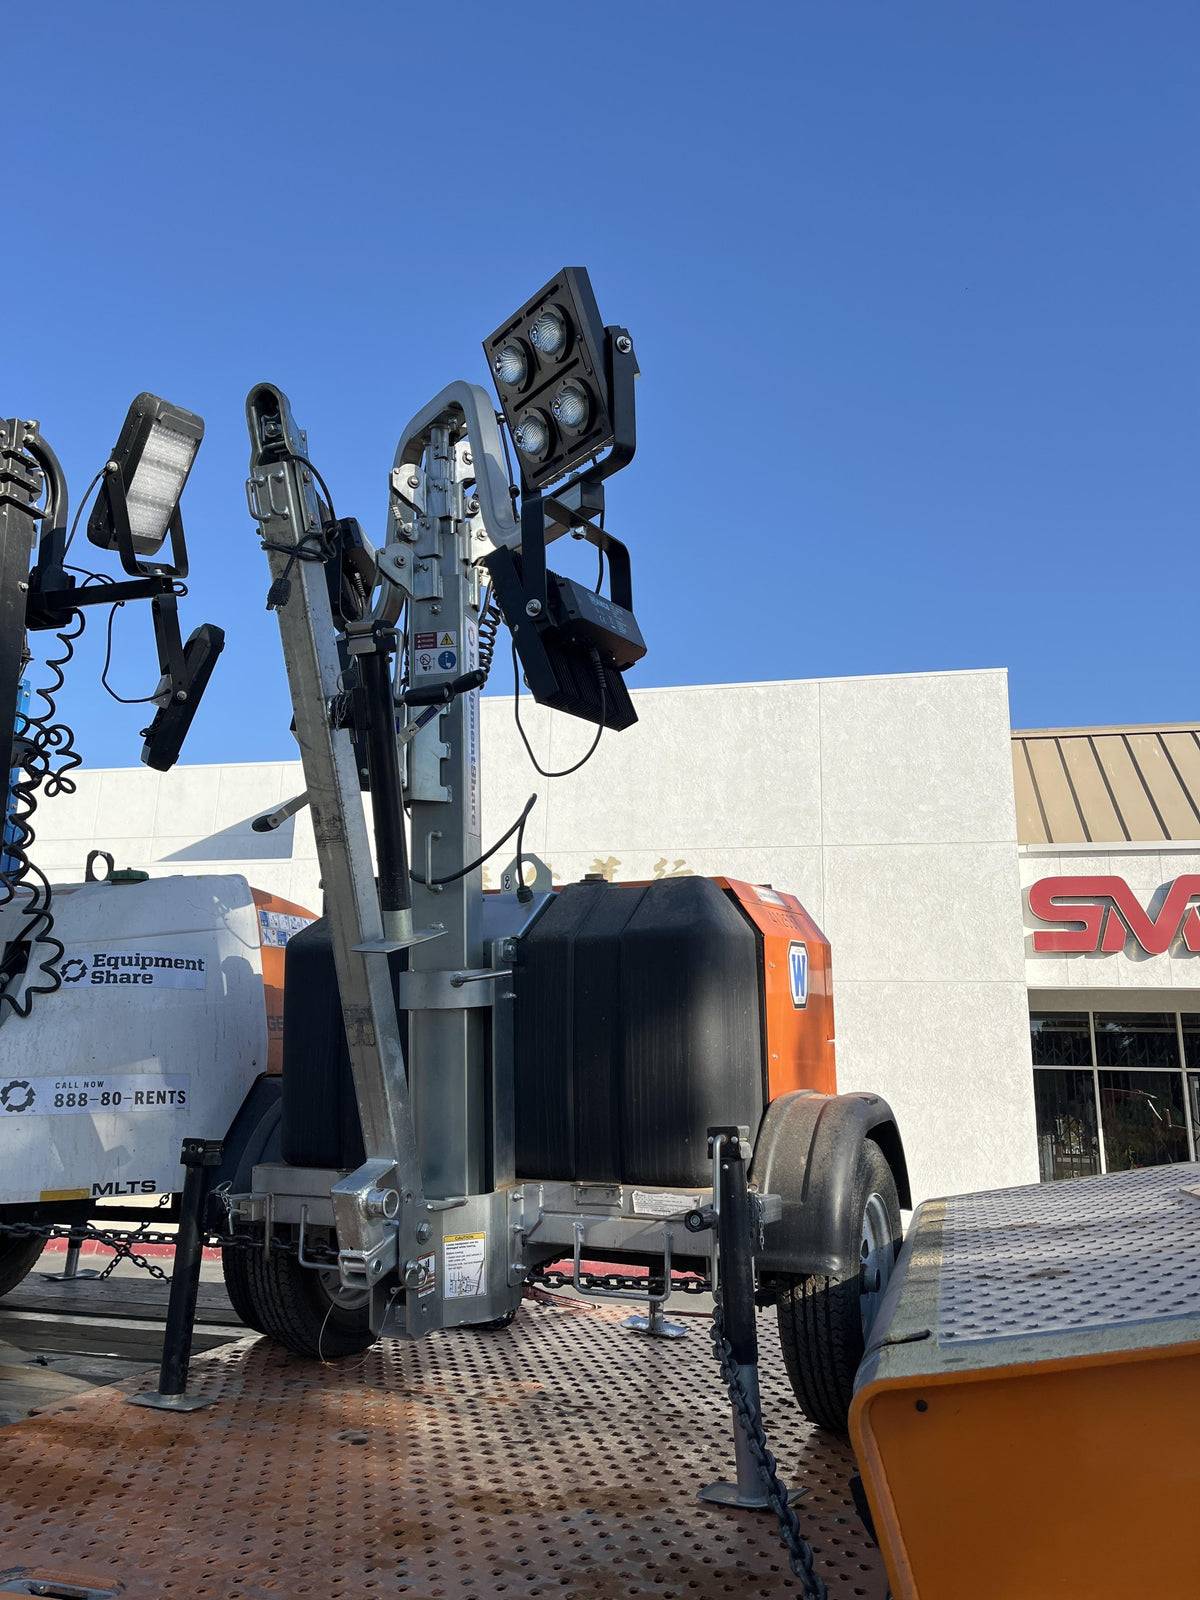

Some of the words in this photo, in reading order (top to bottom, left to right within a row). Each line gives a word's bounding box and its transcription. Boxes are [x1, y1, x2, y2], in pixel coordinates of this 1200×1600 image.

[92, 952, 205, 972] Equipment
[90, 970, 154, 985] Share
[267, 1015, 284, 1032] GE
[55, 1082, 79, 1090] CALL
[83, 1080, 105, 1088] NOW
[53, 1090, 187, 1108] 888-80-RENTS
[92, 1180, 157, 1196] MLTS
